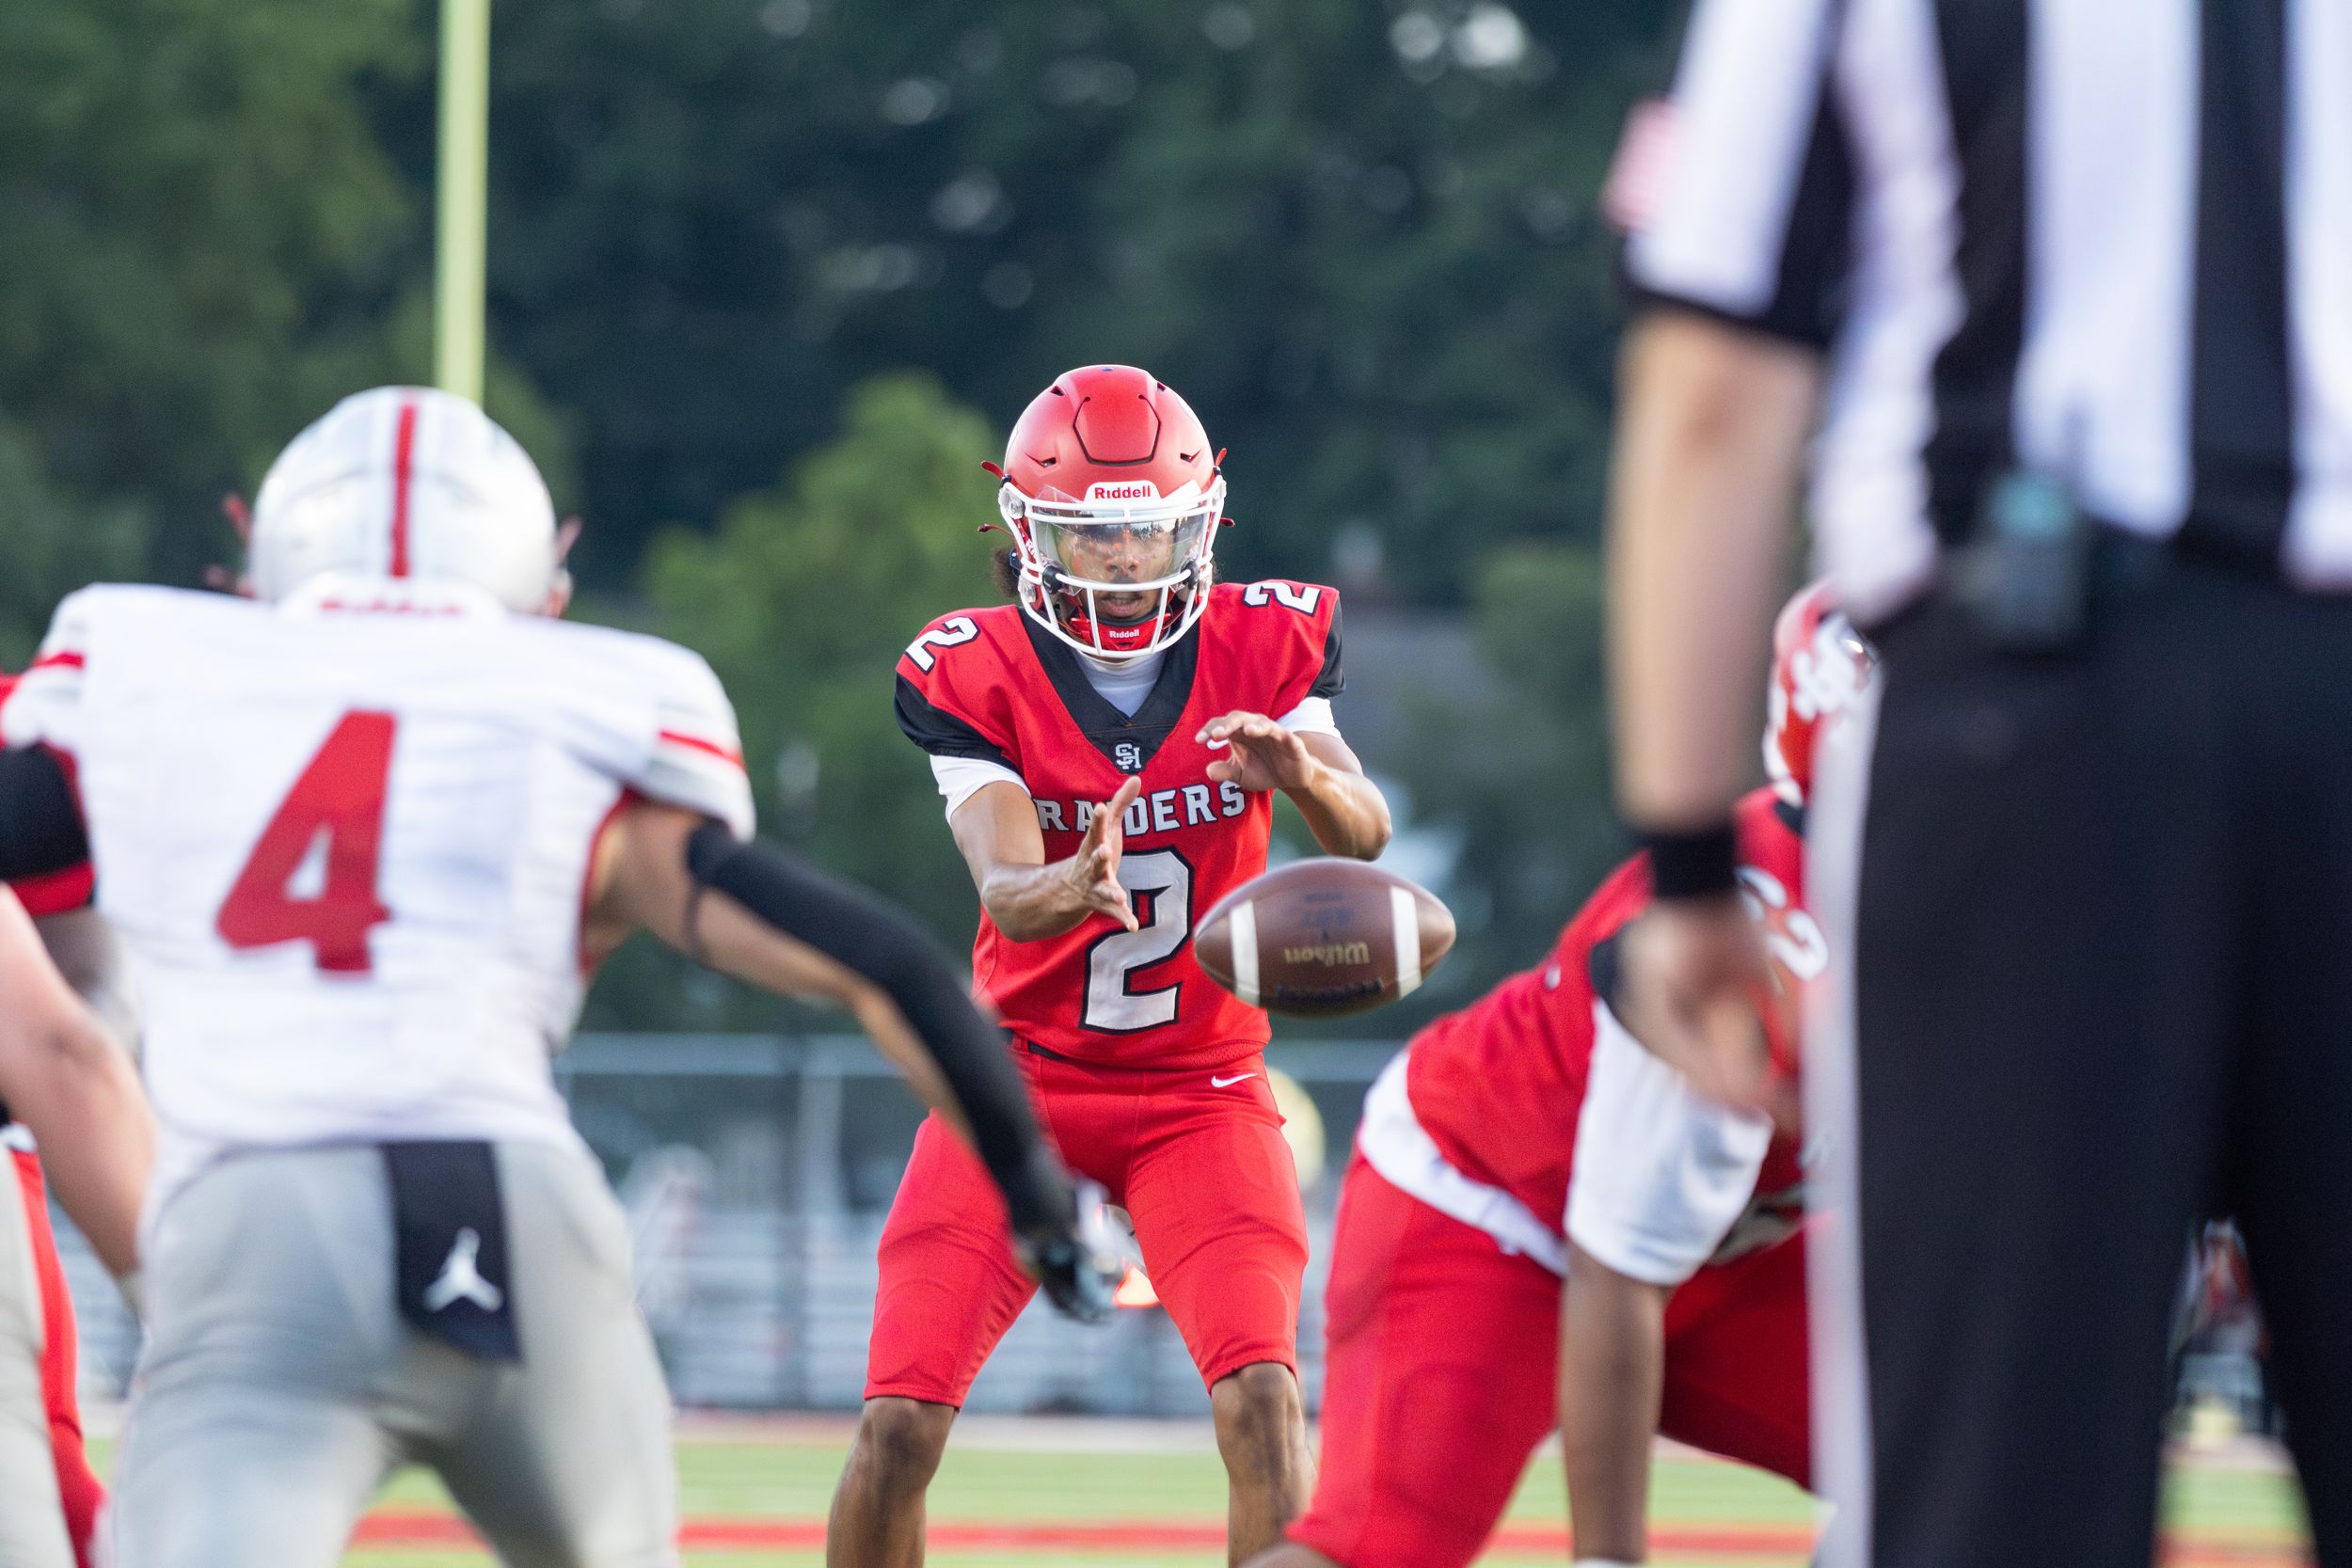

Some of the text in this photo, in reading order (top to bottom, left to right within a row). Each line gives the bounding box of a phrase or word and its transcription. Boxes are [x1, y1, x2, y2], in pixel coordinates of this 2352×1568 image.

[1094, 485, 1151, 499] Riddell
[1243, 581, 1321, 617] 2
[905, 616, 980, 675] 2
[1109, 629, 1140, 639] Riddell
[1034, 780, 1246, 836] RADERS
[215, 708, 398, 972] 4
[1079, 844, 1195, 1035] 2
[1284, 942, 1370, 967] Wilson
